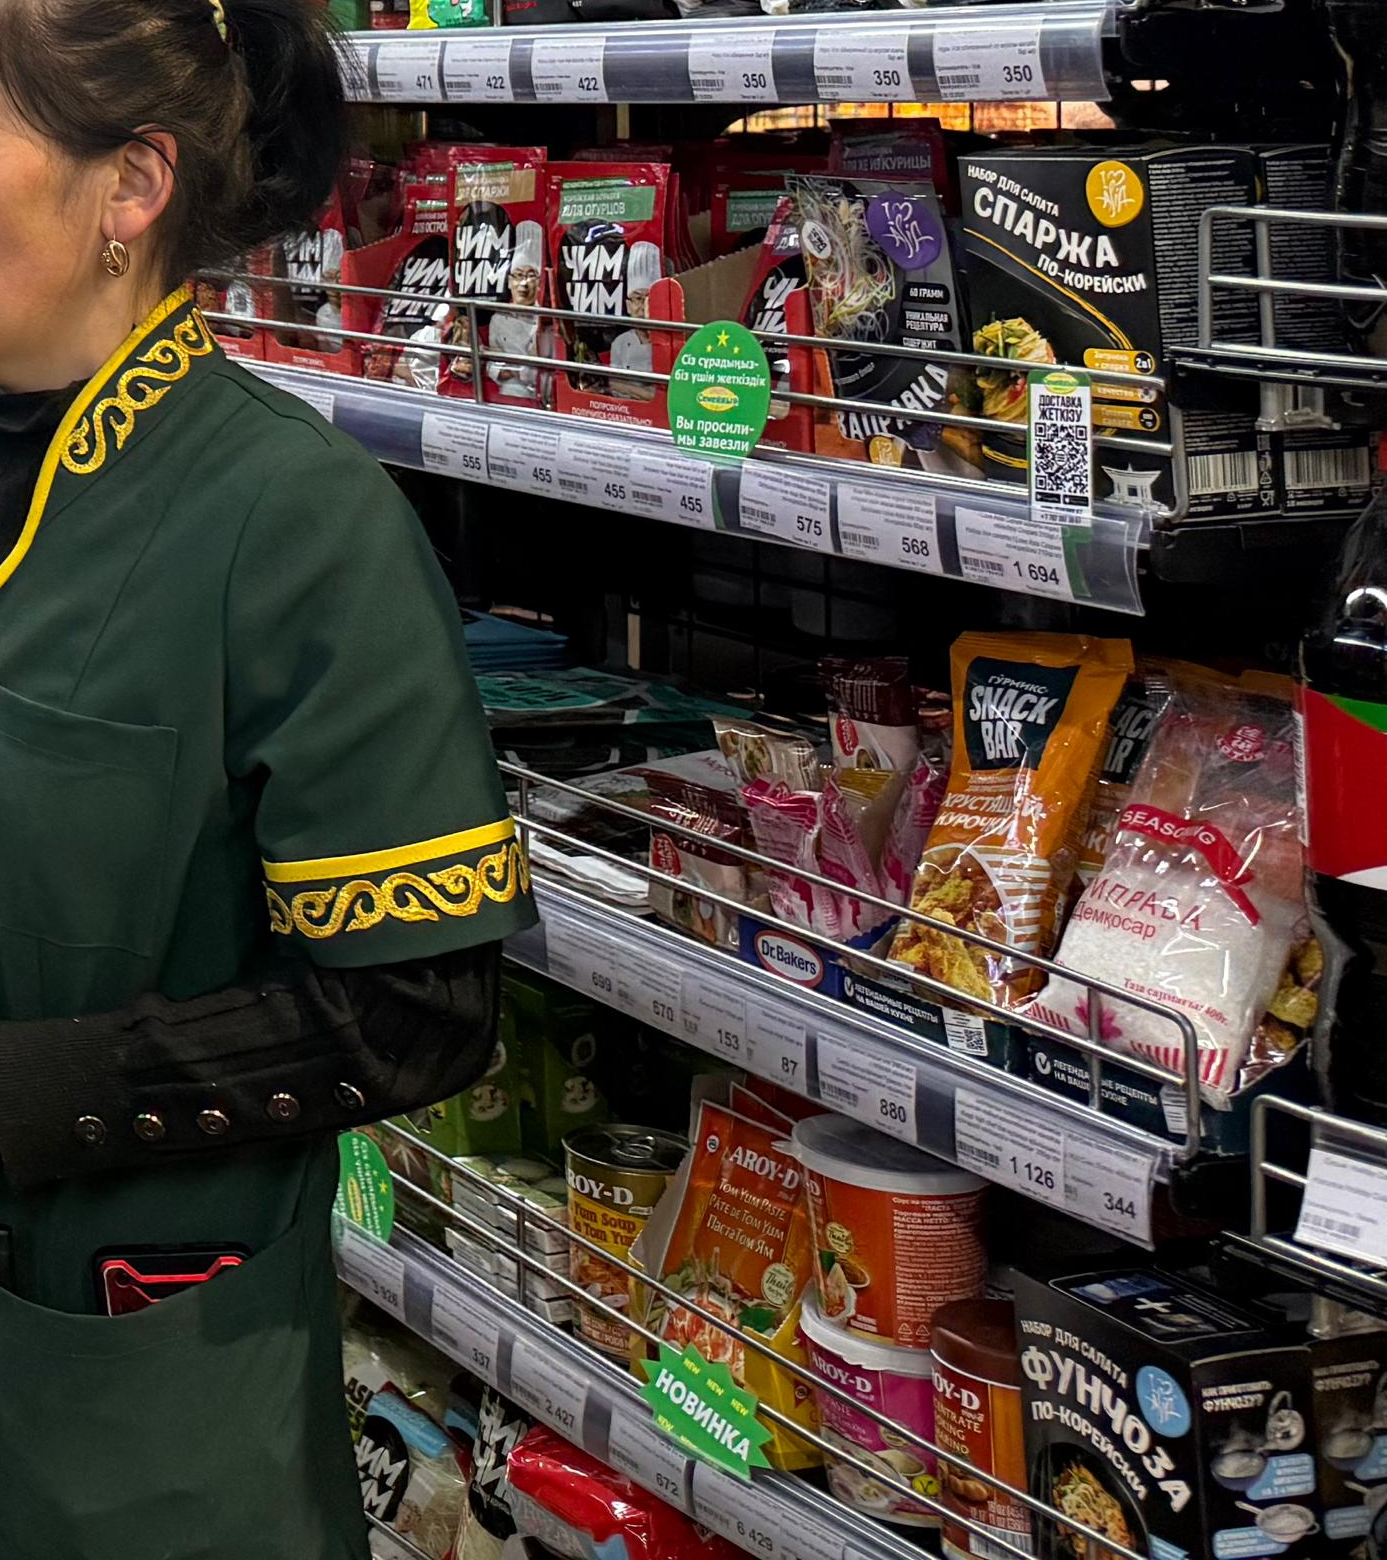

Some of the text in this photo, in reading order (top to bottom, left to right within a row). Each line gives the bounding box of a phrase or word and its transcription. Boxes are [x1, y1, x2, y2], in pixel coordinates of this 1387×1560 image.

[415, 75, 433, 89] 471
[486, 76, 506, 90] 422
[578, 76, 599, 91] 422
[742, 73, 767, 89] 350
[873, 69, 901, 87] 350
[1002, 64, 1033, 83] 350
[881, 156, 932, 171] КУРИЦЫ
[967, 165, 1060, 217] НАБОР ДЛЯ САЛАТА
[585, 203, 626, 217] ОГУРЦОВ
[973, 186, 1120, 269] СПАРЖА
[456, 224, 511, 259] ЧИМ
[562, 243, 626, 282] ЧИМ
[454, 257, 512, 295] ЧИМ
[1037, 253, 1147, 294] ПО-КОРЕЙСКИ
[566, 281, 624, 317] ЧИМ
[681, 354, 696, 366] Сіз
[674, 369, 766, 387] біз үшін жеткіздік
[1038, 394, 1082, 409] ДОСТАВКА
[676, 416, 755, 435] Вы просили-
[1038, 407, 1083, 423] ЖЕТКІЗУ
[677, 434, 749, 451] мы завезли
[462, 455, 482, 471] 555
[532, 466, 552, 484] 455
[604, 483, 626, 500] 455
[680, 495, 703, 514] 455
[795, 515, 823, 536] 575
[901, 536, 930, 557] 568
[1013, 561, 1060, 586] 1 694
[969, 685, 1059, 725] SNACK
[981, 720, 1023, 761] BAR
[592, 971, 612, 992] 699
[652, 999, 674, 1022] 670
[717, 1028, 740, 1051] 153
[781, 1056, 798, 1076] 87
[880, 1099, 906, 1123] 880
[729, 1145, 800, 1190] AROY-D
[1010, 1158, 1055, 1189] 1 126
[566, 1168, 634, 1206] ROY-D
[1103, 1193, 1136, 1219] 344
[471, 1349, 490, 1370] 337
[1021, 1319, 1127, 1388] НАБОР ДЛЯ САЛАТА
[683, 1357, 701, 1375] NEW
[706, 1378, 724, 1396] NEW
[555, 1405, 575, 1428] 427
[655, 1368, 750, 1461] НОВИНКА
[730, 1398, 749, 1416] NEW
[1021, 1345, 1193, 1513] ФУНЧОЗА
[1031, 1400, 1148, 1500] ПО-КОРЕЙСКИ
[656, 1473, 678, 1496] 672
[736, 1519, 773, 1551] 6 429
